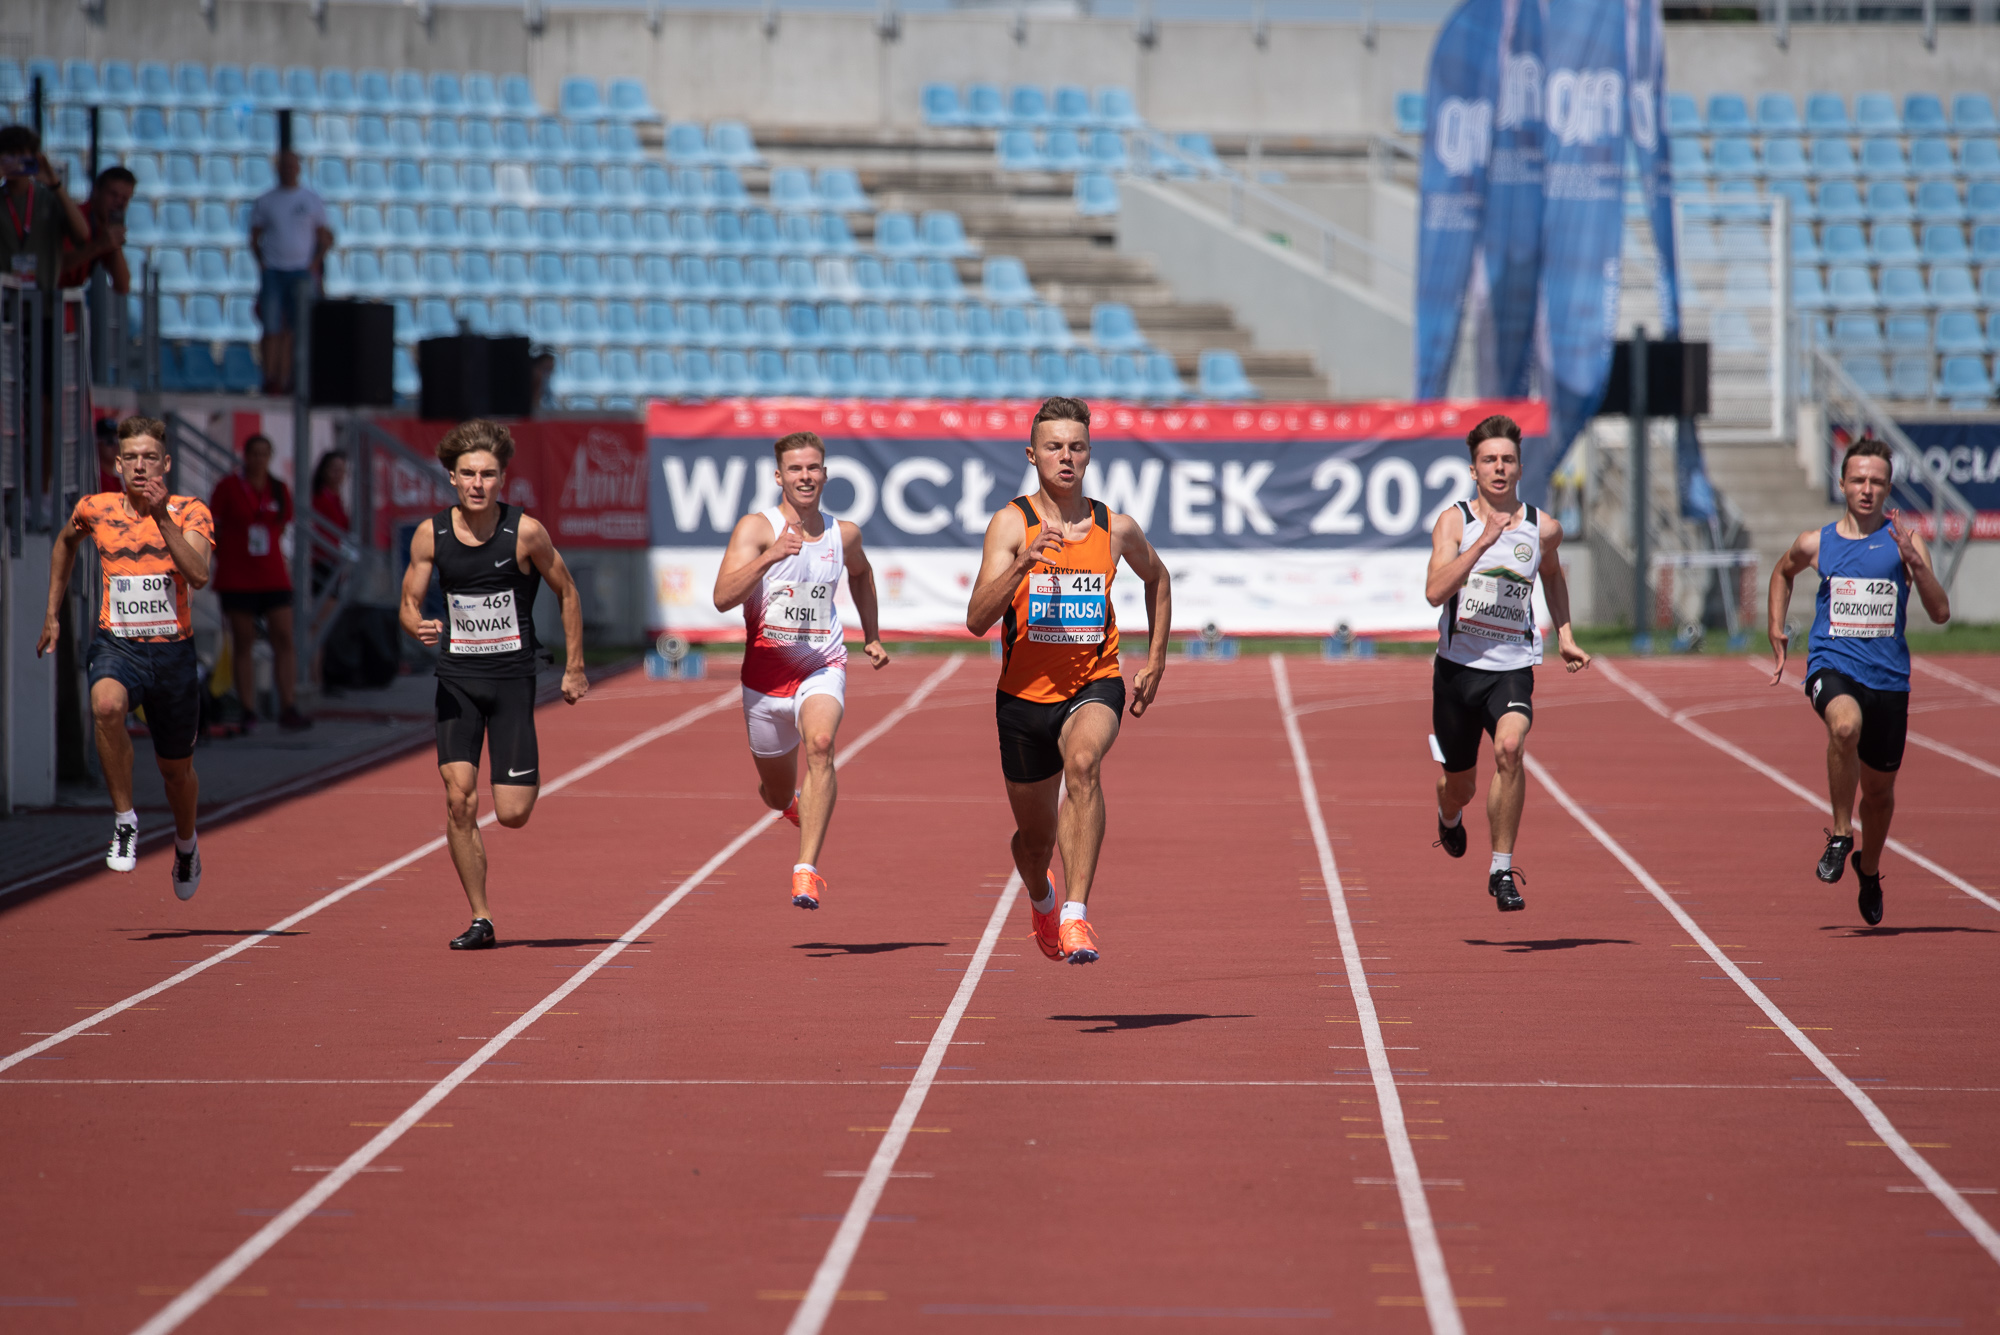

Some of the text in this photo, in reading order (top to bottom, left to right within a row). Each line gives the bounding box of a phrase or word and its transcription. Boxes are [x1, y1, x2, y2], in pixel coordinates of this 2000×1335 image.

[939, 408, 1212, 431] MISTOSTWA
[1232, 409, 1371, 431] POLSKI
[1310, 455, 1475, 536] 202
[143, 577, 172, 591] 809
[1072, 577, 1102, 592] 414
[1866, 582, 1894, 595] 422
[810, 585, 827, 599] 62
[1503, 584, 1528, 600] 249
[116, 599, 169, 615] FLOREK
[482, 594, 511, 609] 469
[1833, 601, 1894, 616] GORZKOWICZ
[784, 606, 817, 621] KISIL
[1030, 601, 1103, 619] PIETRUSA
[1465, 598, 1526, 623] CHAŁADZIŃSKI
[158, 626, 175, 635] 2021
[455, 615, 512, 632] NOWAK
[767, 630, 811, 642] WŁOCŁAWEK
[1032, 633, 1102, 643] WŁOCŁAWEK 2021
[1461, 624, 1505, 641] WŁOCŁAWEK
[1505, 633, 1522, 643] 2021
[1833, 628, 1891, 637] WŁOCŁAWEK 2021
[454, 641, 517, 653] WŁOCŁAWEK 2021
